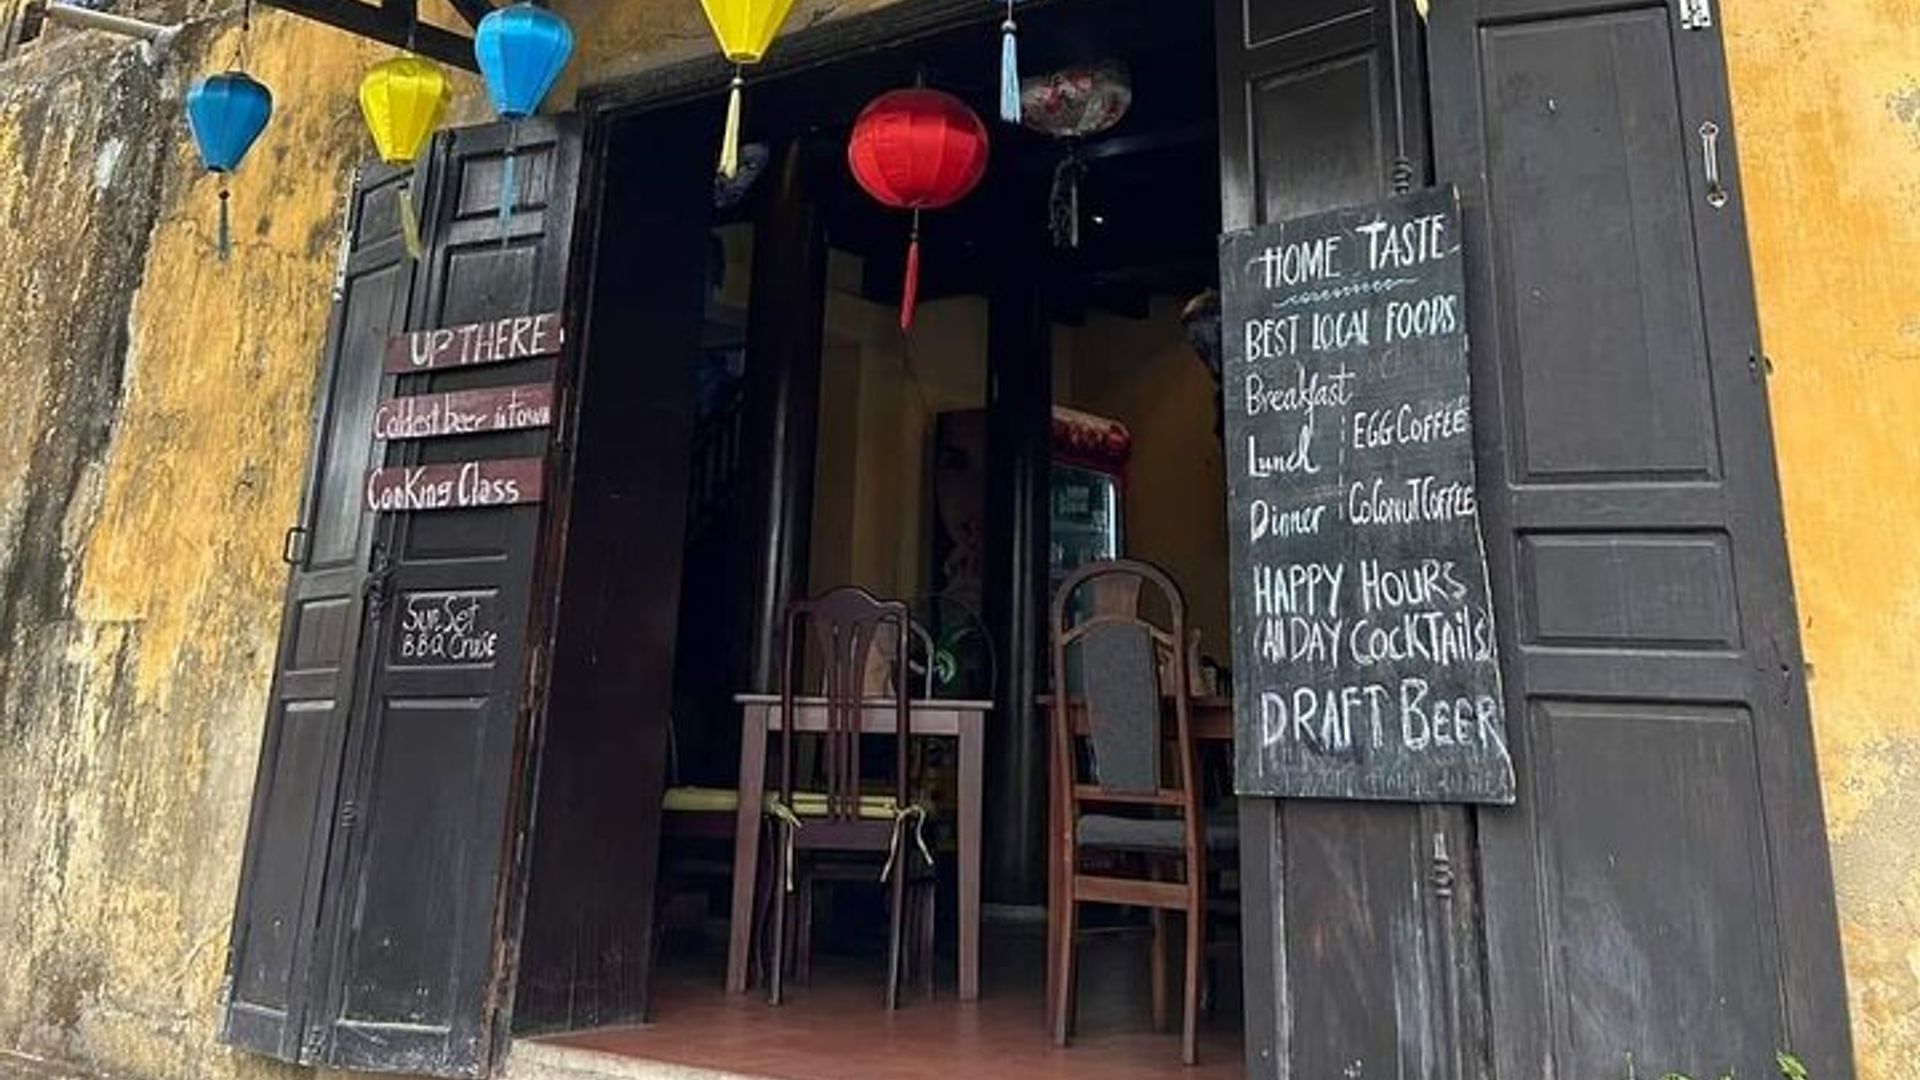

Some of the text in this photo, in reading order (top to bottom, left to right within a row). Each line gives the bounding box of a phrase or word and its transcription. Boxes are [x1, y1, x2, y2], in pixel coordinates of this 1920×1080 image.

[1248, 213, 1446, 288] HOME TASTE
[411, 312, 554, 368] UP THERE
[1246, 295, 1458, 362] BEST LOCAL FOODS
[375, 397, 440, 440] Coldest
[444, 392, 488, 435] beer
[1246, 362, 1356, 430] Breakfast
[1249, 425, 1320, 478] Lunch
[1354, 409, 1396, 449] EGG
[457, 460, 521, 507] Class
[1251, 500, 1326, 543] Dinner
[1253, 558, 1468, 618] HAPPY HOURS
[1289, 616, 1344, 668] DAY
[1261, 684, 1389, 750] DRAFT
